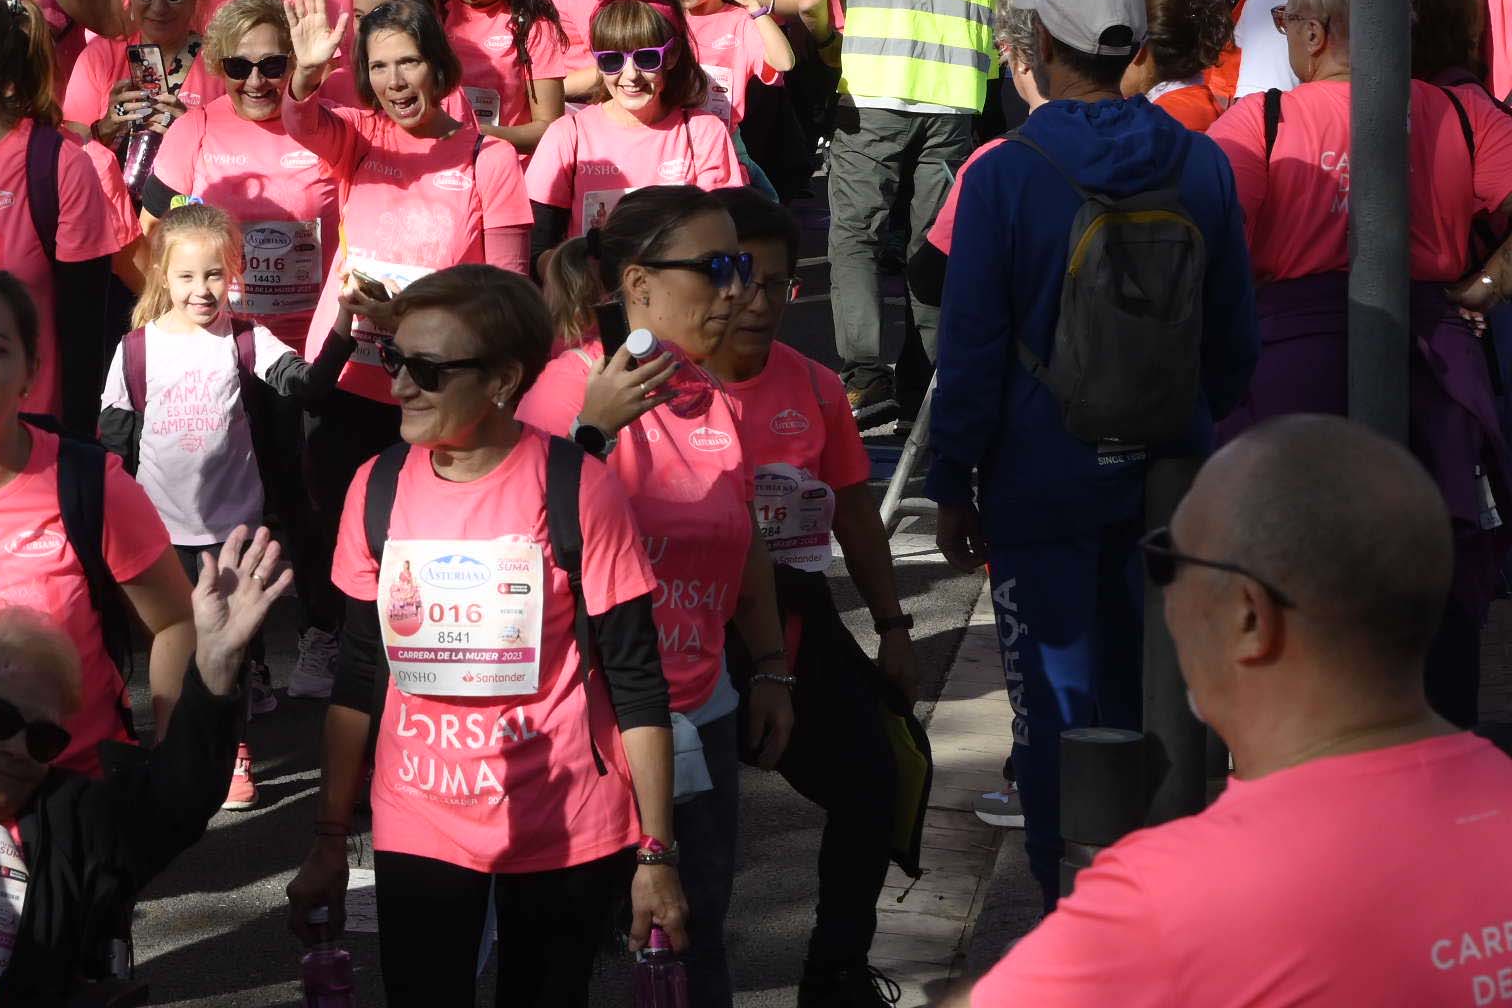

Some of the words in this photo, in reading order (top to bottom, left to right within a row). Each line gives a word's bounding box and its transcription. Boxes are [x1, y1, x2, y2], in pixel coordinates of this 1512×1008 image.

[249, 256, 285, 271] 016
[253, 274, 281, 284] 14433
[167, 406, 180, 418] ES
[185, 404, 209, 416] UNA
[151, 417, 224, 436] CAMPEONA
[425, 566, 486, 582] ASTURIANA
[497, 563, 530, 573] SUMA
[428, 602, 483, 624] 016
[438, 631, 471, 644] 8541
[398, 650, 436, 660] CARRERA
[437, 651, 451, 661] DE
[452, 651, 464, 661] LA
[465, 652, 499, 661] MUJER
[501, 651, 523, 661] 2023
[398, 670, 437, 683] OYSHO
[476, 672, 526, 684] Santander
[398, 749, 505, 796] SUMA
